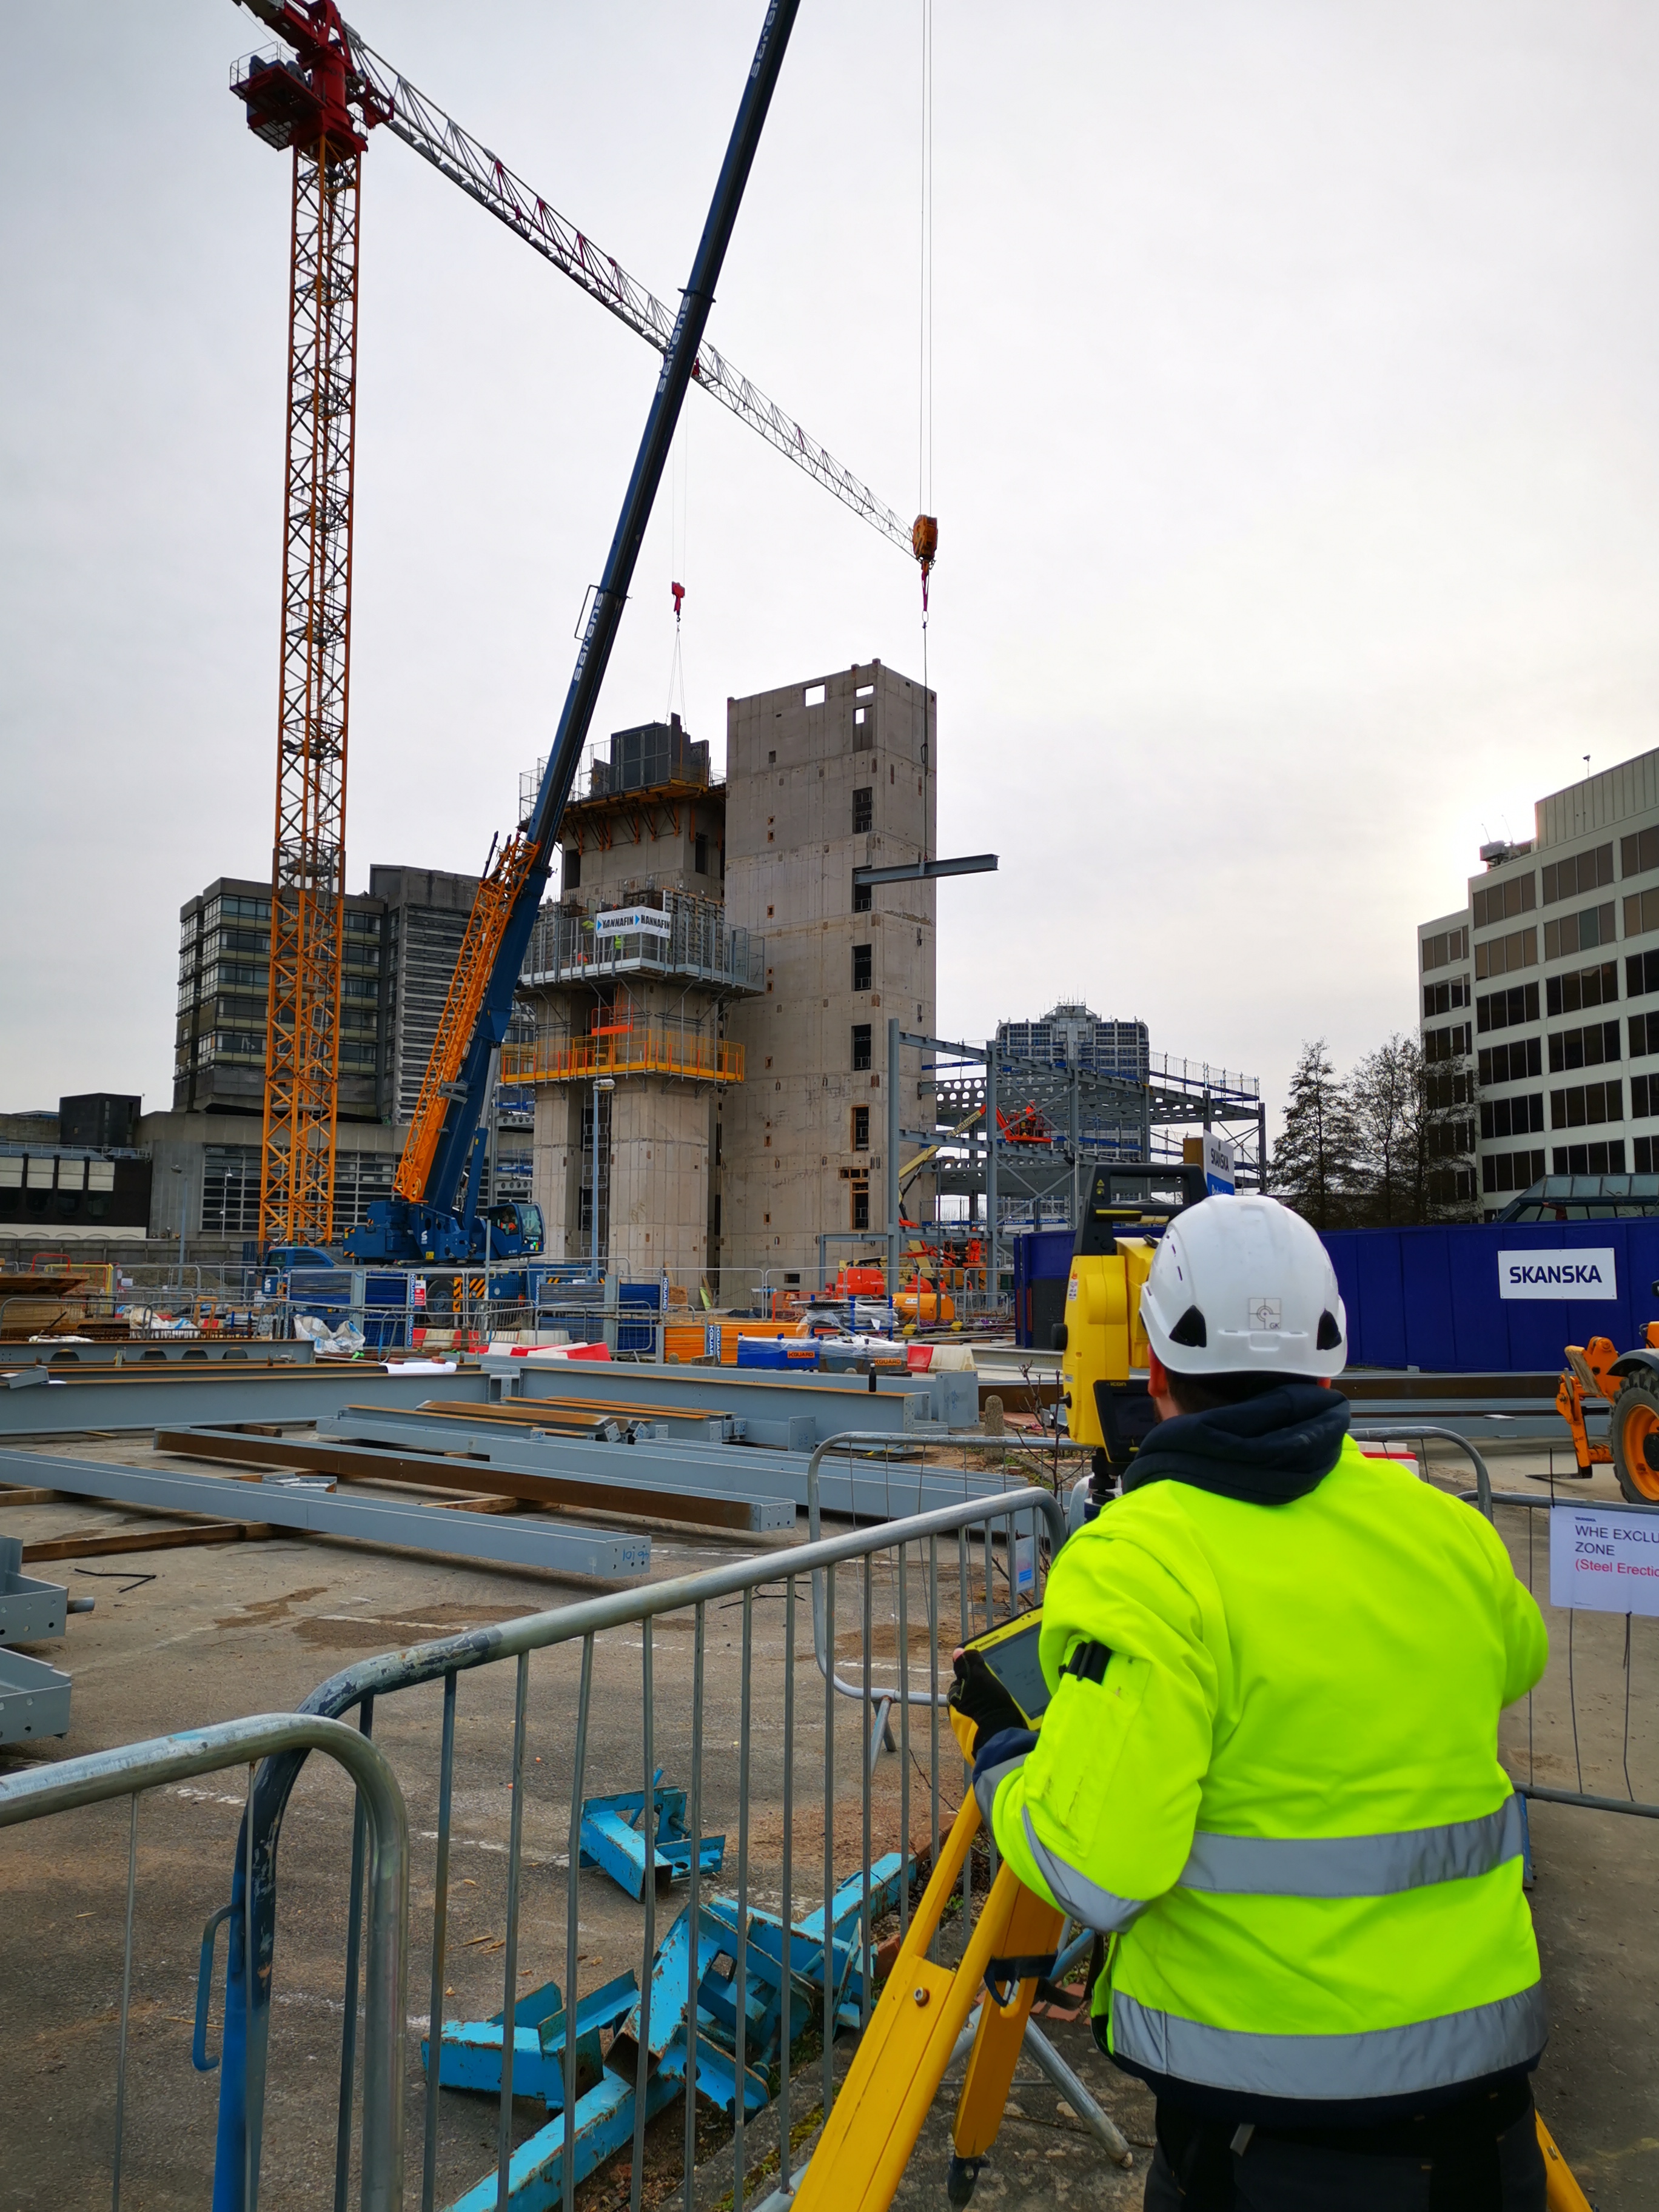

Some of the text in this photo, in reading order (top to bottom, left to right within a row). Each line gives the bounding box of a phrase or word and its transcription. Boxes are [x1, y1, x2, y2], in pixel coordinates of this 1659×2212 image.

[658, 295, 690, 393] sarens
[574, 592, 604, 682] sarens
[641, 914, 670, 930] HANNAFIN
[954, 1113, 979, 1133] Platforms
[1211, 1148, 1230, 1172] SKANSKA
[1510, 1265, 1603, 1283] SKANSKA
[1575, 1524, 1609, 1538] WHE
[1575, 1541, 1615, 1556] ZONE
[1575, 1558, 1613, 1572] (Steel
[974, 1635, 1000, 1649] Panasonic
